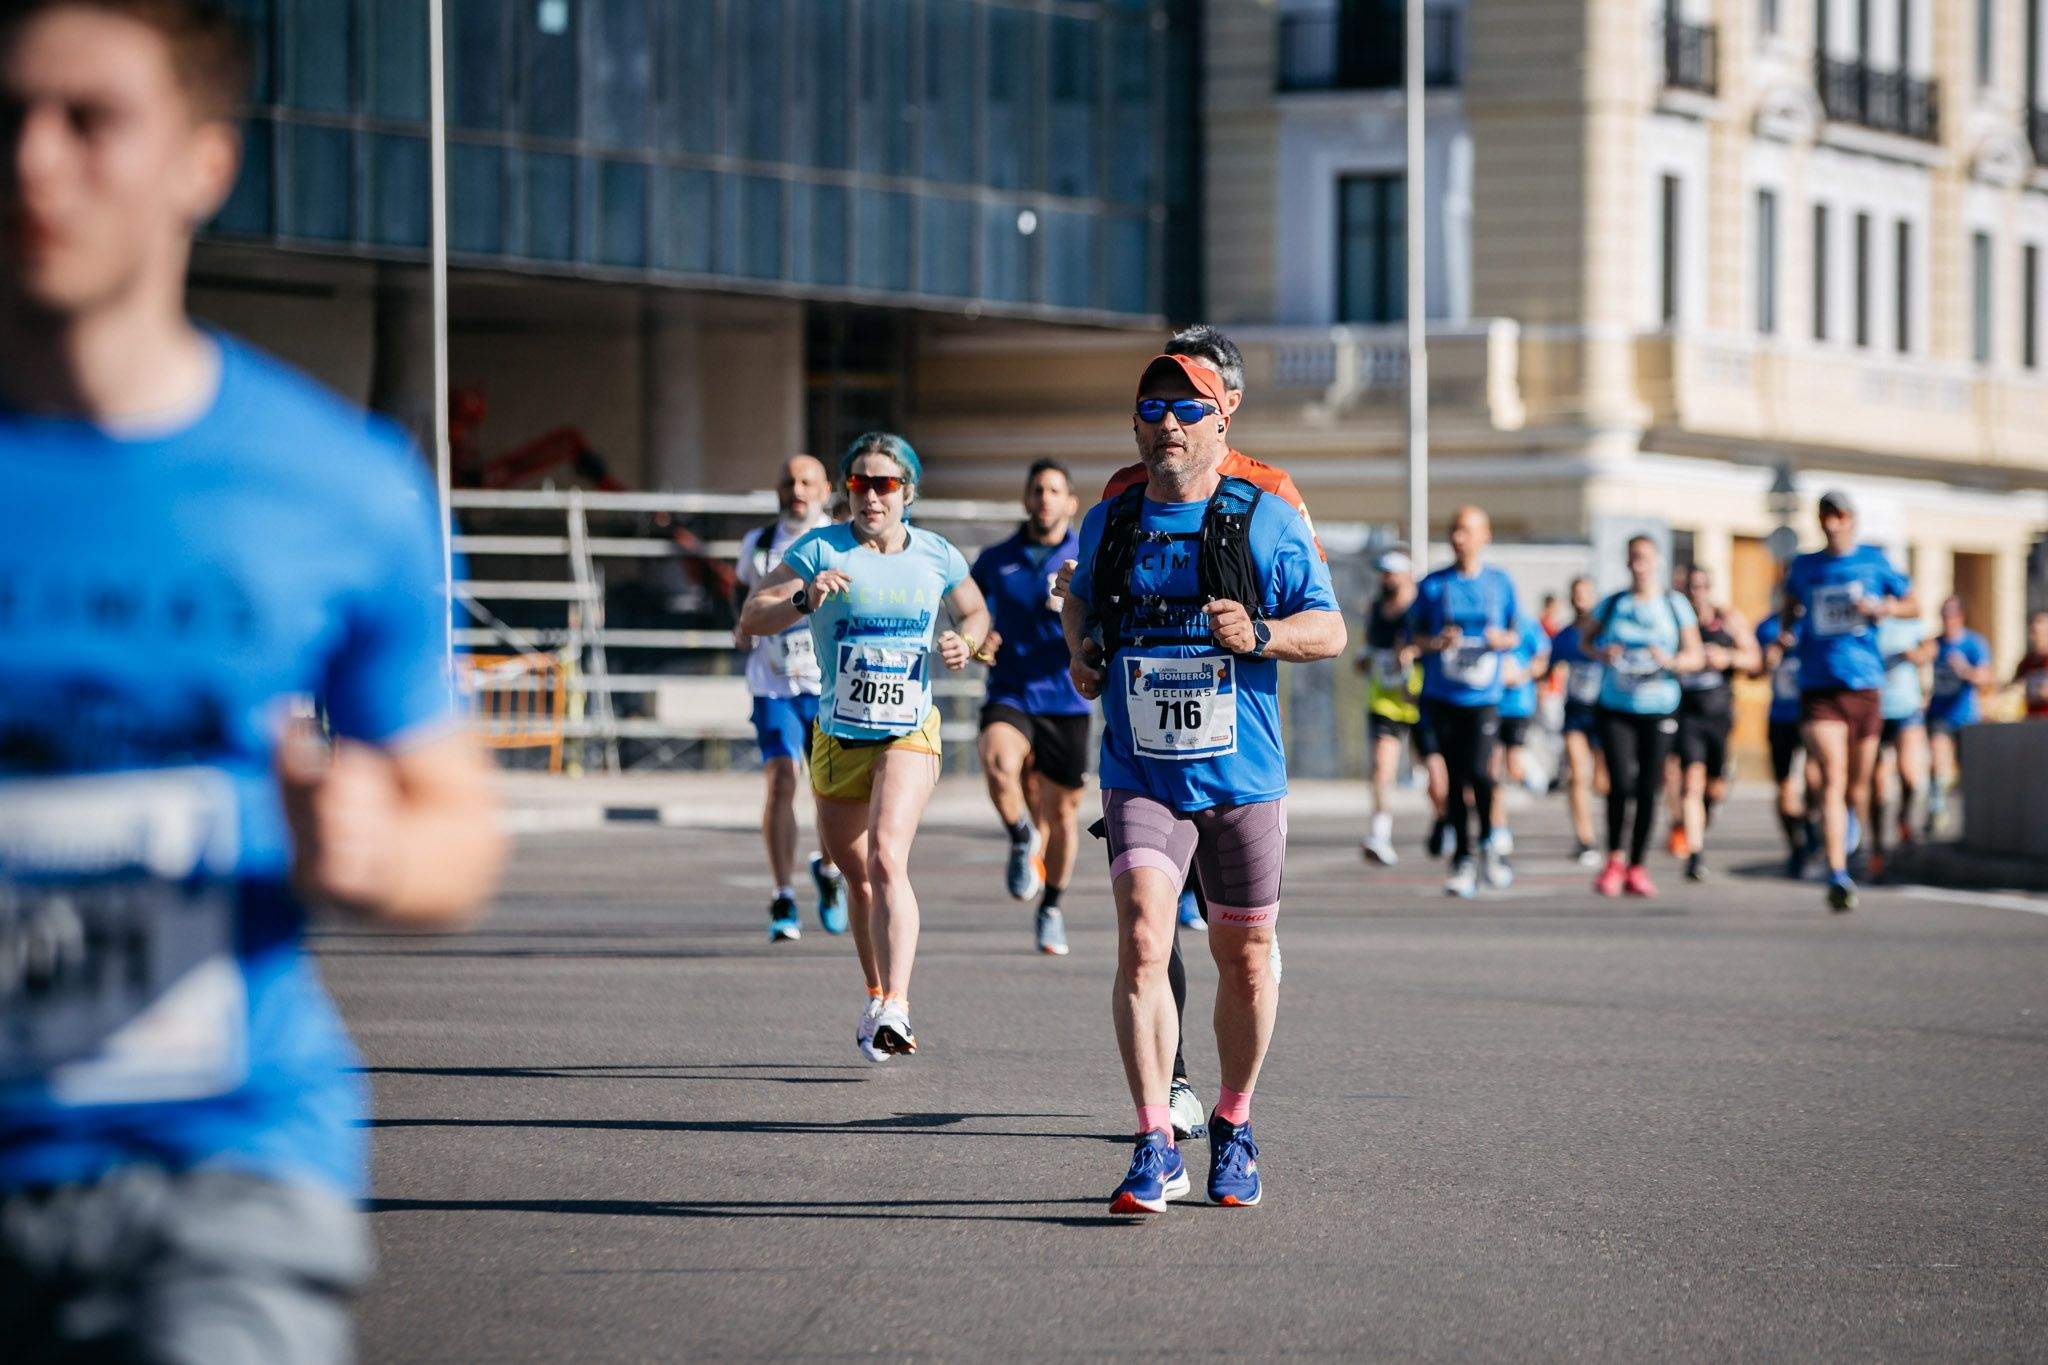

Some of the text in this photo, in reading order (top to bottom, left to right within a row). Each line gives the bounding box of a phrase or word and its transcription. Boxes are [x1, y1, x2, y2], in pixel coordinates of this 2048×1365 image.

[1141, 552, 1191, 571] CIM
[1159, 671, 1212, 681] BOMBEROS
[849, 678, 904, 706] 2035
[1153, 688, 1212, 698] DECIMAS
[1155, 700, 1202, 730] 716
